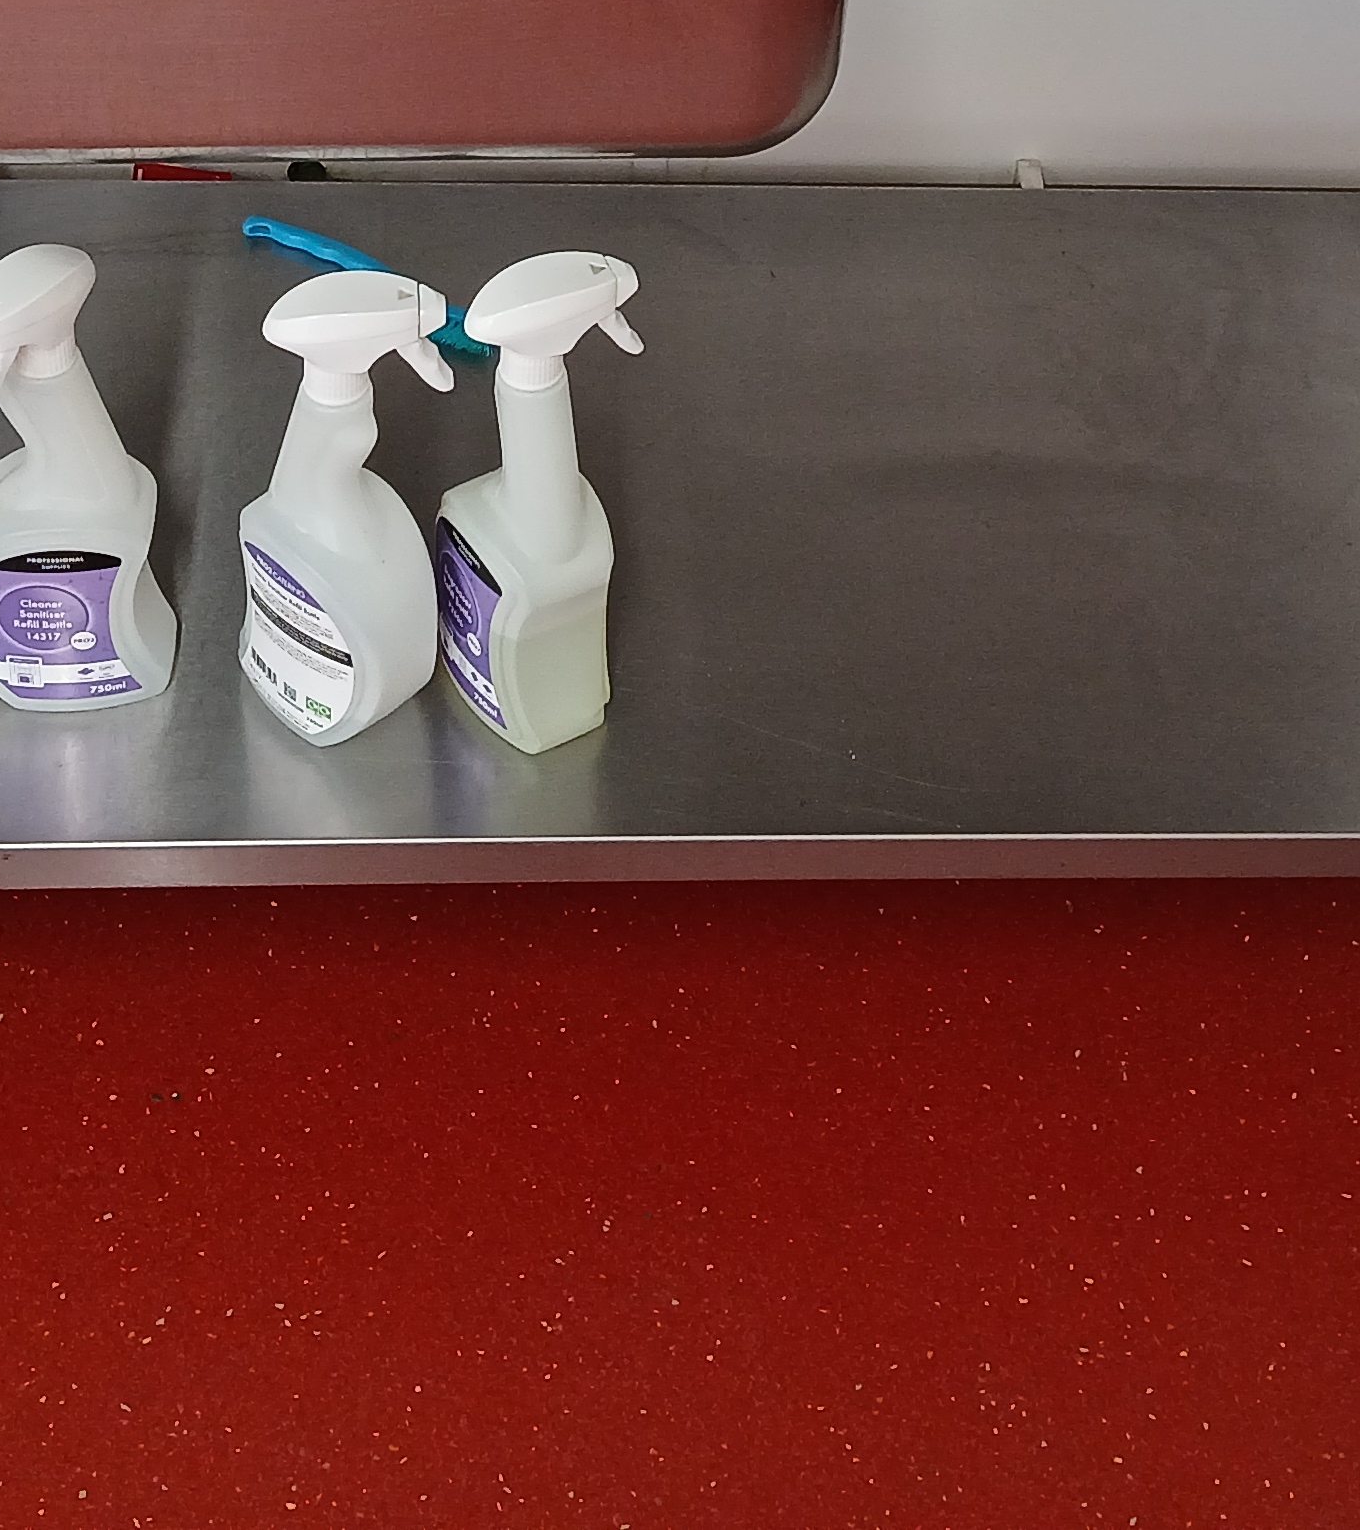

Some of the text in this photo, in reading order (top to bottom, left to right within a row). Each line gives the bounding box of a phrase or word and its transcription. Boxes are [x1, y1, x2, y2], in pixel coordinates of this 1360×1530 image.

[19, 599, 63, 609] Cleaner
[19, 609, 65, 619] Sanitiser
[13, 619, 73, 629] Refill Bottle
[89, 681, 127, 694] 750ml
